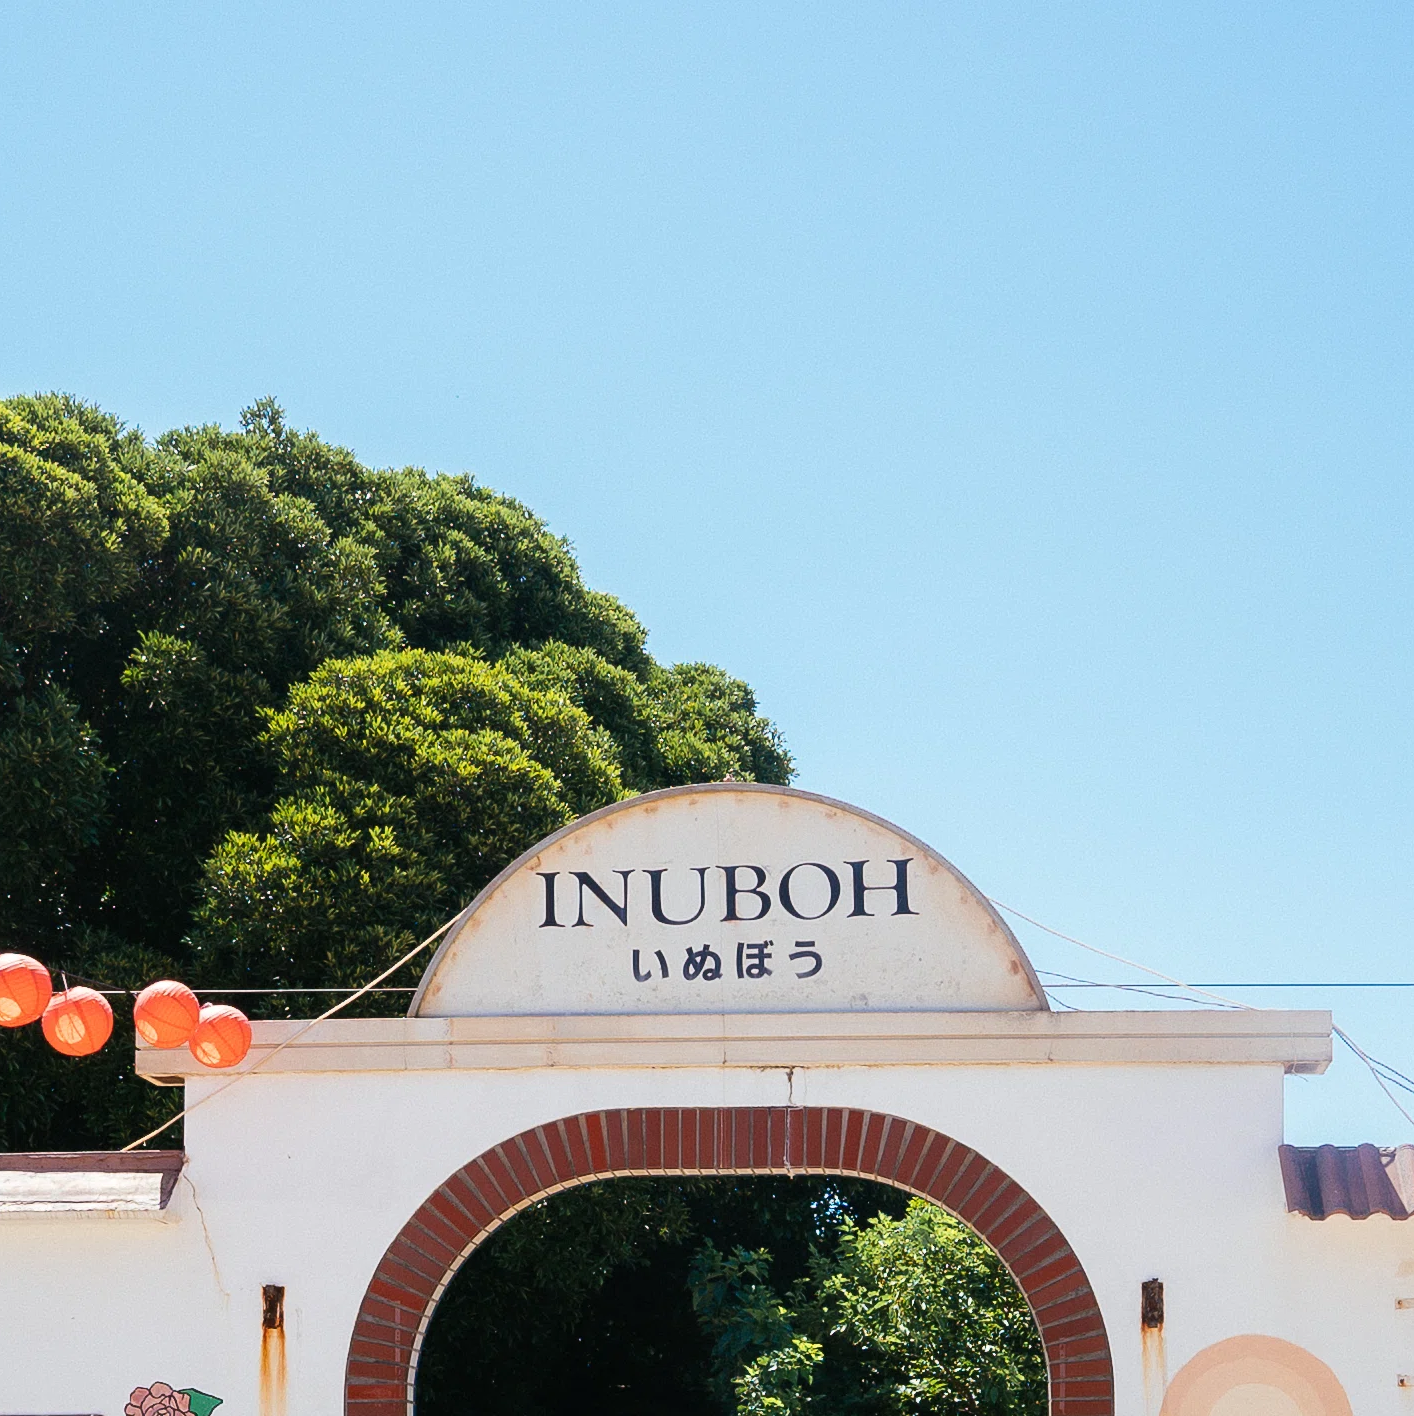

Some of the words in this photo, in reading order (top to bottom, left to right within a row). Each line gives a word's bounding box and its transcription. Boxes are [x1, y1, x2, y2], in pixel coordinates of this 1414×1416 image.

[536, 857, 920, 928] INUBOH
[632, 940, 823, 982] いぬぼう
